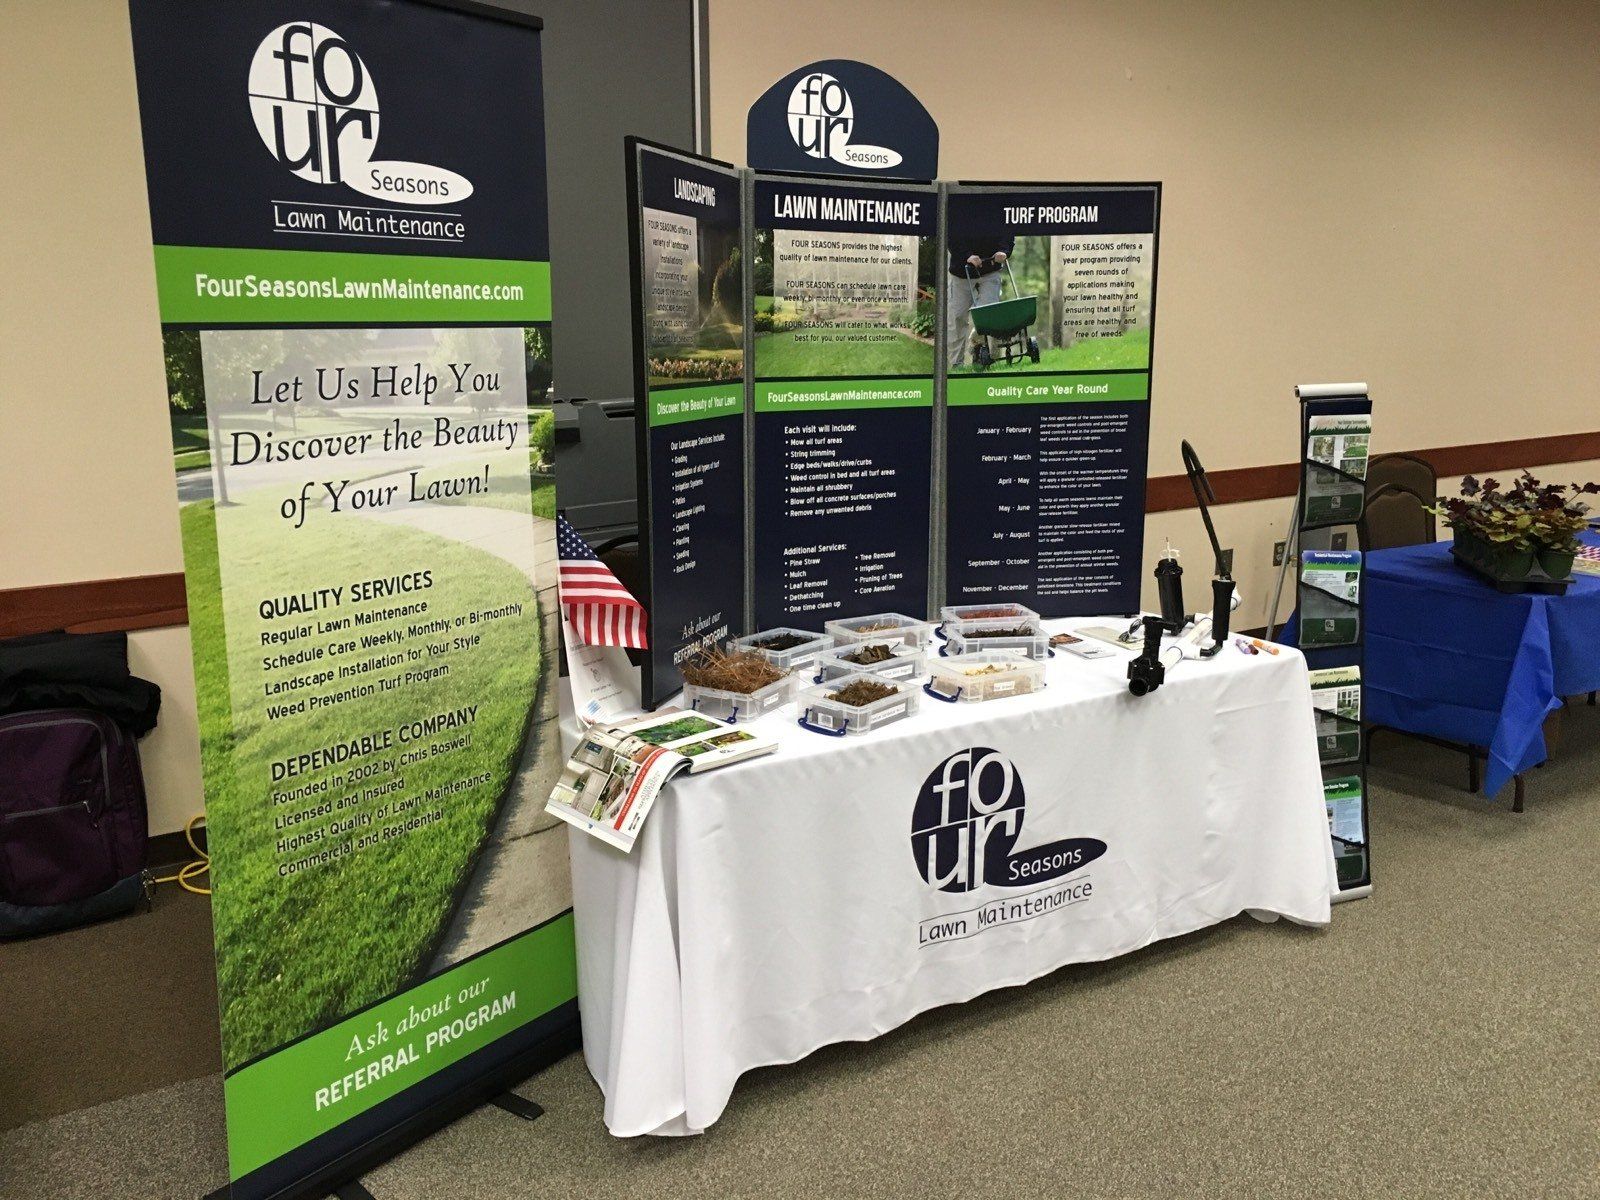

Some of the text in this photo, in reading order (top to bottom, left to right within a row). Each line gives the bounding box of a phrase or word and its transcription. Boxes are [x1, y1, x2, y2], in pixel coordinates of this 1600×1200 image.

[845, 150, 888, 164] Seasons
[371, 170, 449, 196] Seasons
[674, 177, 715, 207] LANDSCAPING
[274, 206, 465, 237] Lawn Maintenance
[774, 195, 920, 225] LAWN MAINTENANCE
[1004, 206, 1098, 224] TURF PROGRAM
[792, 240, 809, 248] FOUR
[811, 241, 840, 249] SEASONS
[842, 242, 867, 251] provides
[881, 244, 902, 252] highest
[892, 257, 912, 265] clients.
[1063, 255, 1140, 265] year program providing
[195, 274, 523, 300] FourSeasonsLawnMaintenance.com
[1067, 281, 1135, 290] applications making
[1099, 293, 1124, 301] healthy
[1066, 306, 1094, 314] ensuring
[1097, 318, 1121, 326] healthy
[251, 363, 500, 405] Let Us Help You
[768, 390, 921, 402] FourSeasonsLawnMaintenance.com
[987, 384, 1108, 398] Quality Care Year Round
[657, 402, 680, 415] Discover
[690, 398, 706, 411] Beauty
[708, 397, 712, 408] of
[714, 396, 723, 406] Your
[725, 396, 736, 405] Lawn
[231, 417, 518, 466] Discover the Beauty
[784, 426, 800, 434] Each
[802, 425, 816, 433] visit
[818, 425, 830, 433] will
[977, 427, 1000, 435] January
[982, 454, 1007, 462] February
[1018, 477, 1030, 485] May
[281, 464, 490, 528] of Your Lawn!
[999, 505, 1010, 513] May
[1010, 531, 1030, 539] August
[784, 543, 847, 556] Additional Services:
[259, 571, 433, 619] QUALITY SERVICES
[261, 601, 428, 646] Regular Lawn Maintenance
[263, 603, 523, 671] Schedule Care Weekly, Monthly, or Bi-monthly
[265, 633, 480, 695] Landscape Installation for Your Style
[267, 663, 449, 720] Weed Prevention Turf Program
[271, 705, 478, 781] DEPENDABLE COMPANY
[273, 735, 471, 806] Founded in 2002 by Chris Boswell
[275, 778, 405, 829] Licensed and Insured
[277, 771, 491, 853] Highest Quality of Lawn Maintenance
[279, 809, 444, 877] Commercial and Residential
[1009, 849, 1082, 880] Seasons
[919, 882, 1092, 944] Lawn Maintenance
[345, 977, 490, 1062] Ask about our
[315, 991, 516, 1111] REFERRAL PROGRAM
